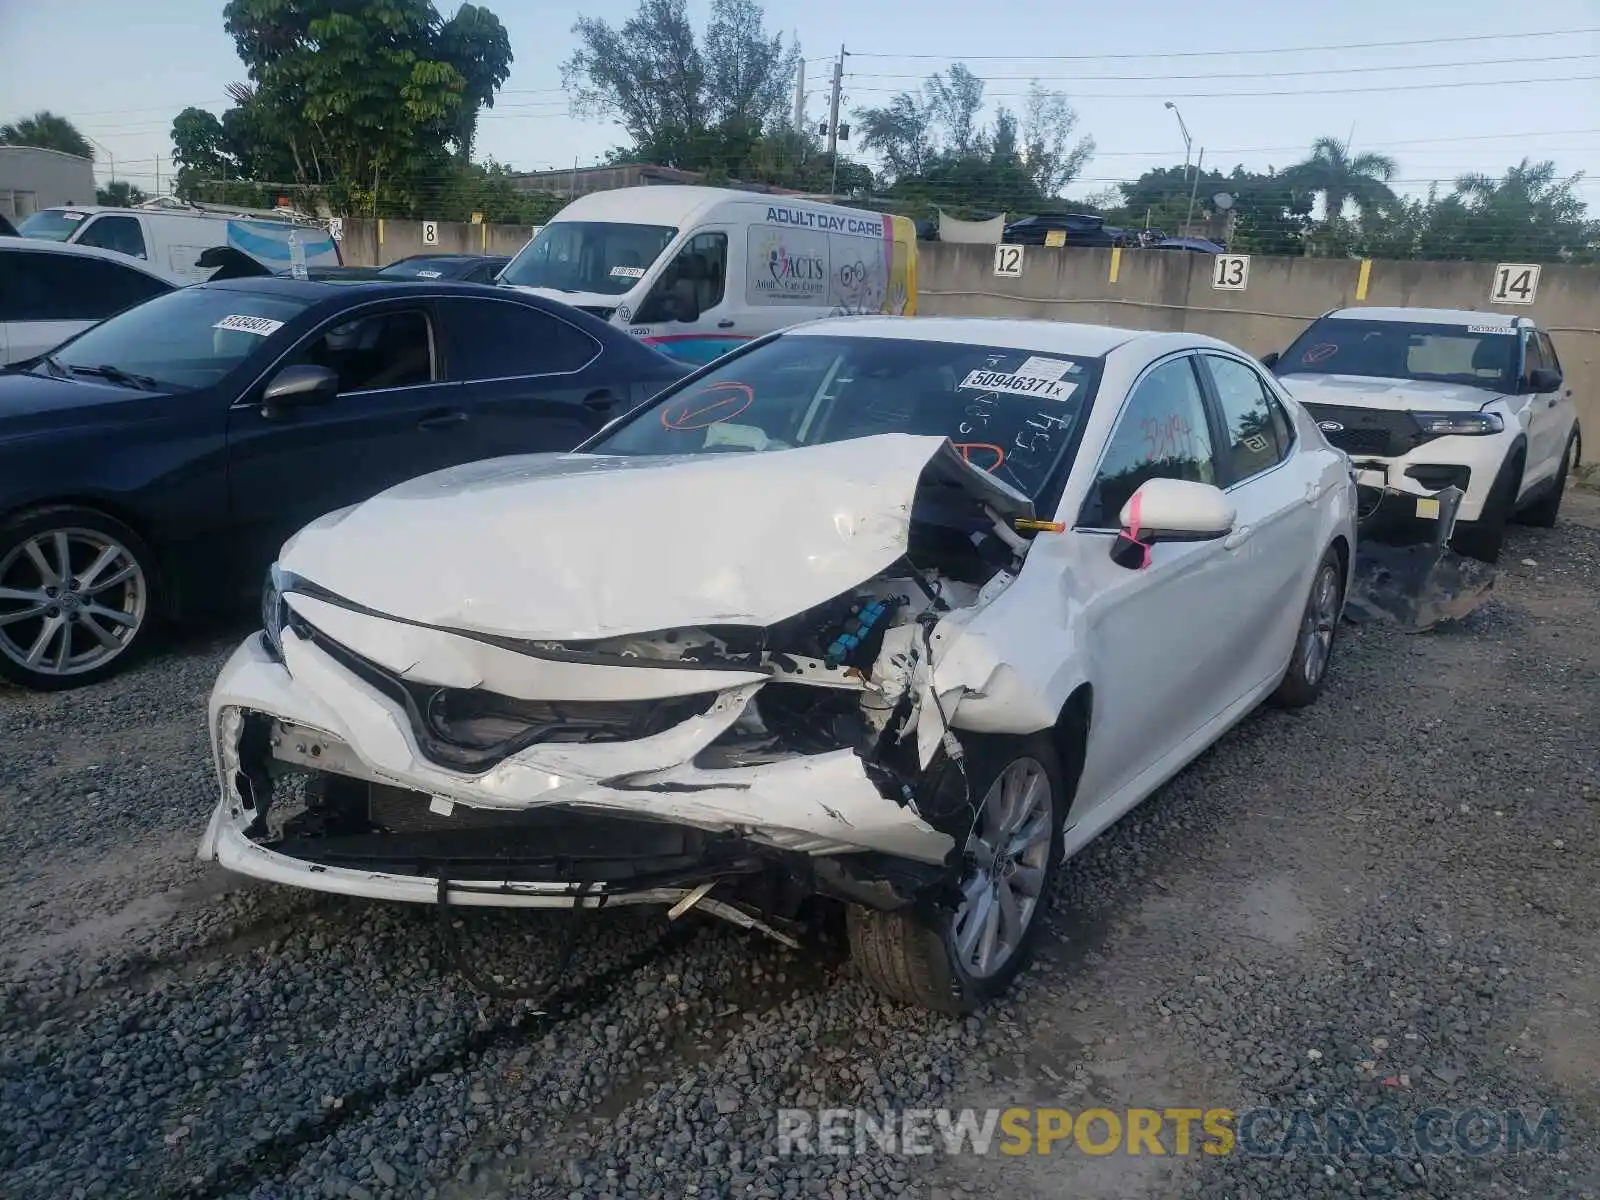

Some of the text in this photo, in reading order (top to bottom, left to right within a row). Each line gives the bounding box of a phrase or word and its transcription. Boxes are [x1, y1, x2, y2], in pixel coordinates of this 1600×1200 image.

[426, 224, 435, 242] 8
[766, 207, 883, 237] ADULT DAY CARE
[786, 255, 824, 280] ACTS
[998, 248, 1020, 273] 12
[1217, 259, 1244, 285] 13
[1496, 269, 1531, 299] 14
